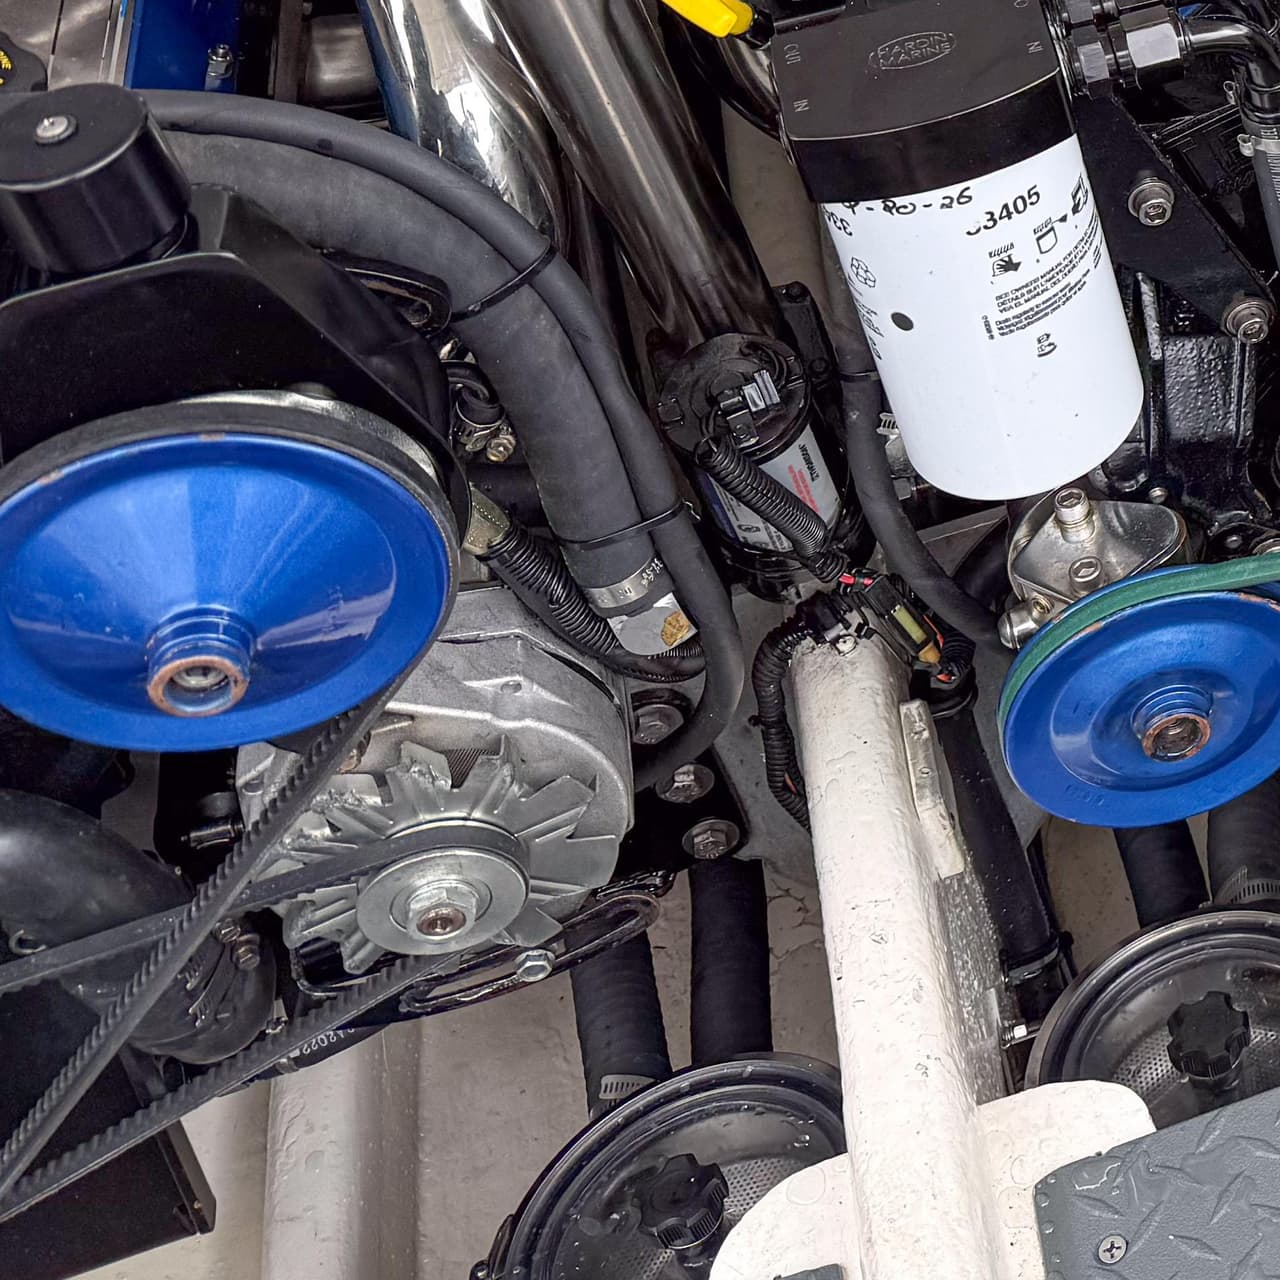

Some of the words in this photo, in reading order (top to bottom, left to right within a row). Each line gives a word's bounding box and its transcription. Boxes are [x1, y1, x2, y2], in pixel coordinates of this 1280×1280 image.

[877, 33, 948, 58] HARDIN
[879, 42, 951, 67] MARINE
[1026, 40, 1044, 54] IN
[792, 99, 809, 113] IN
